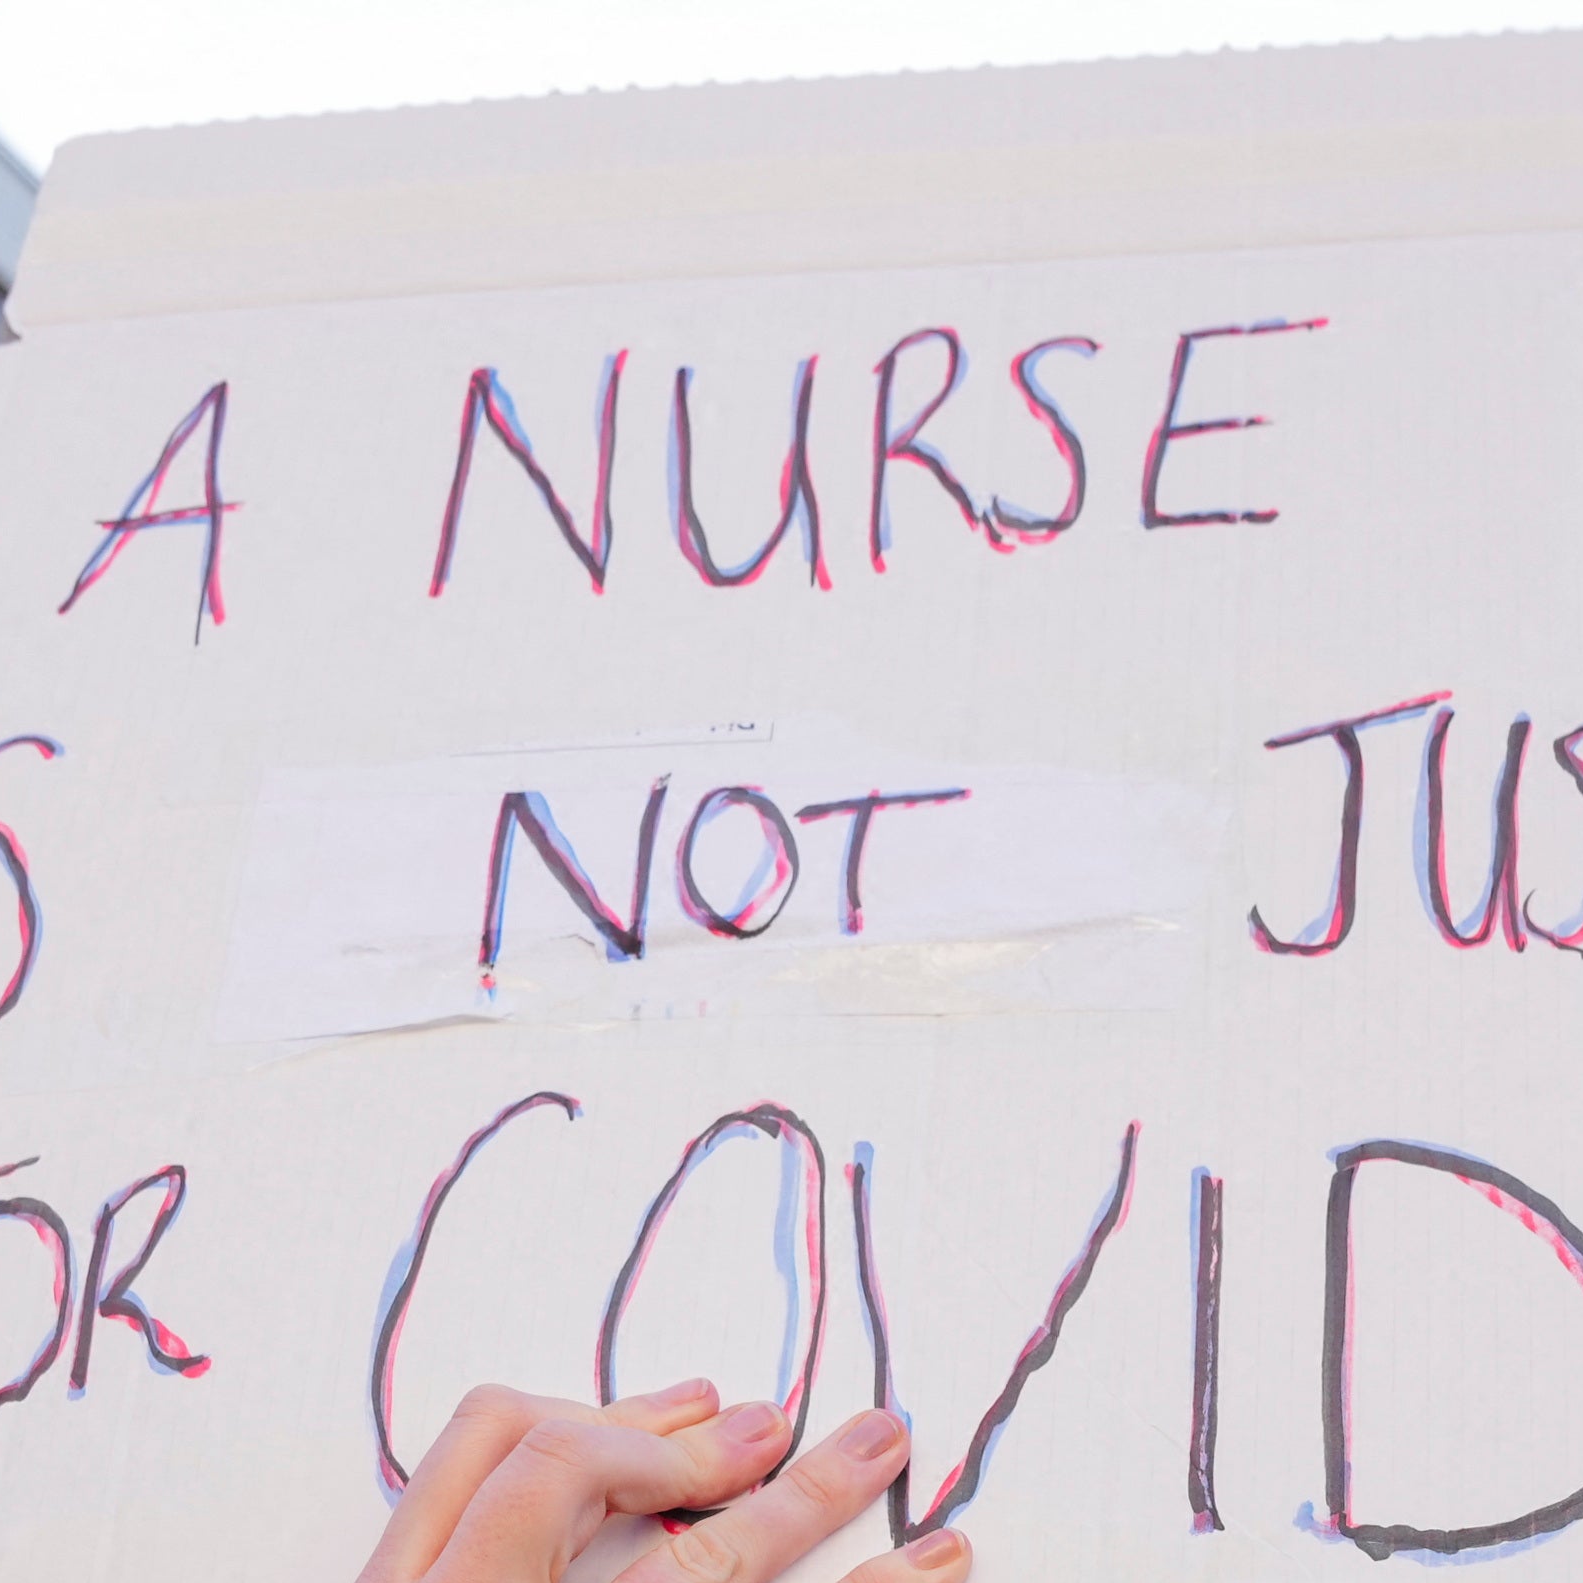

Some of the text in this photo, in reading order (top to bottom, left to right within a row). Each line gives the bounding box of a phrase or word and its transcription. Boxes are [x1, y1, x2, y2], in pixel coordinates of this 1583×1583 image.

[58, 318, 1329, 645] A NURSE
[478, 773, 971, 998] NOT
